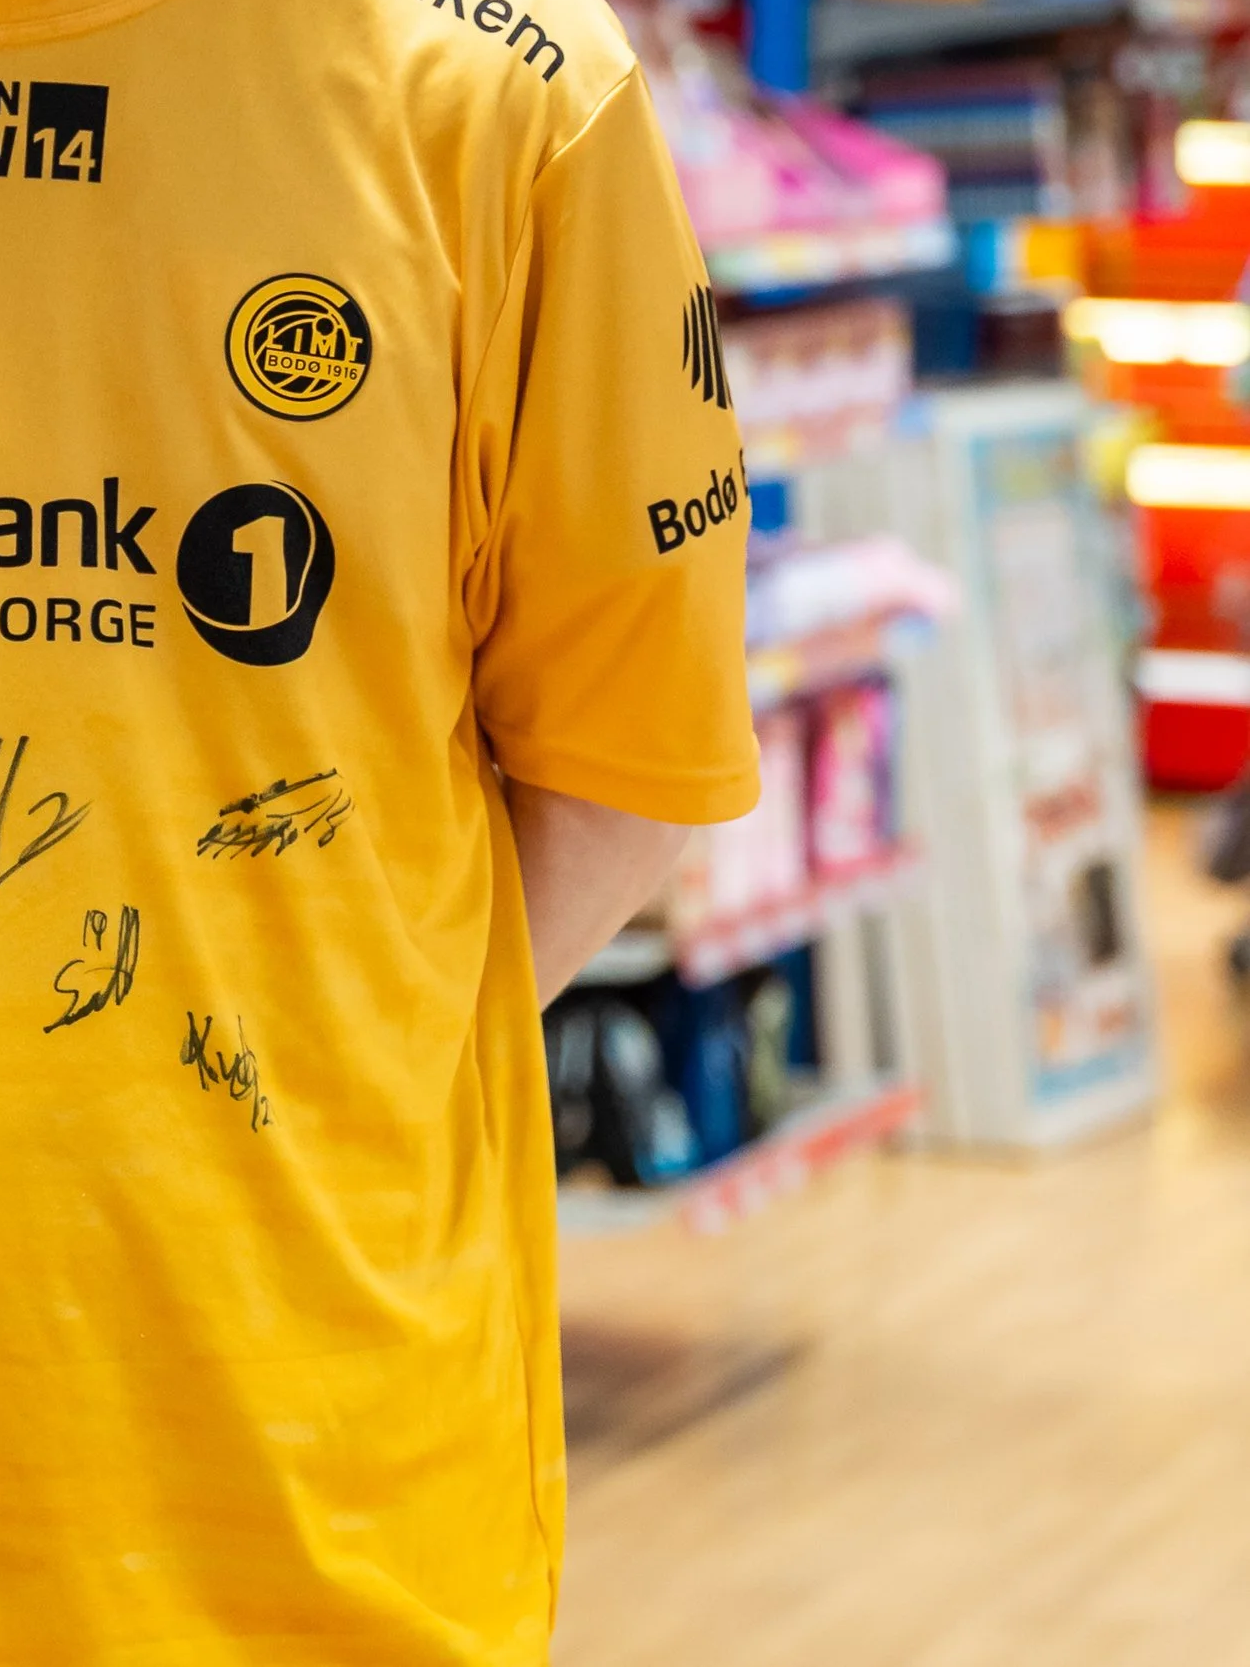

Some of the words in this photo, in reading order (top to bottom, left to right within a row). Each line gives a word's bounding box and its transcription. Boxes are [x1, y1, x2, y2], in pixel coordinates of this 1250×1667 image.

[32, 127, 97, 183] 14
[267, 353, 321, 374] BODØ
[326, 363, 358, 381] 1916
[647, 467, 738, 555] Bodø
